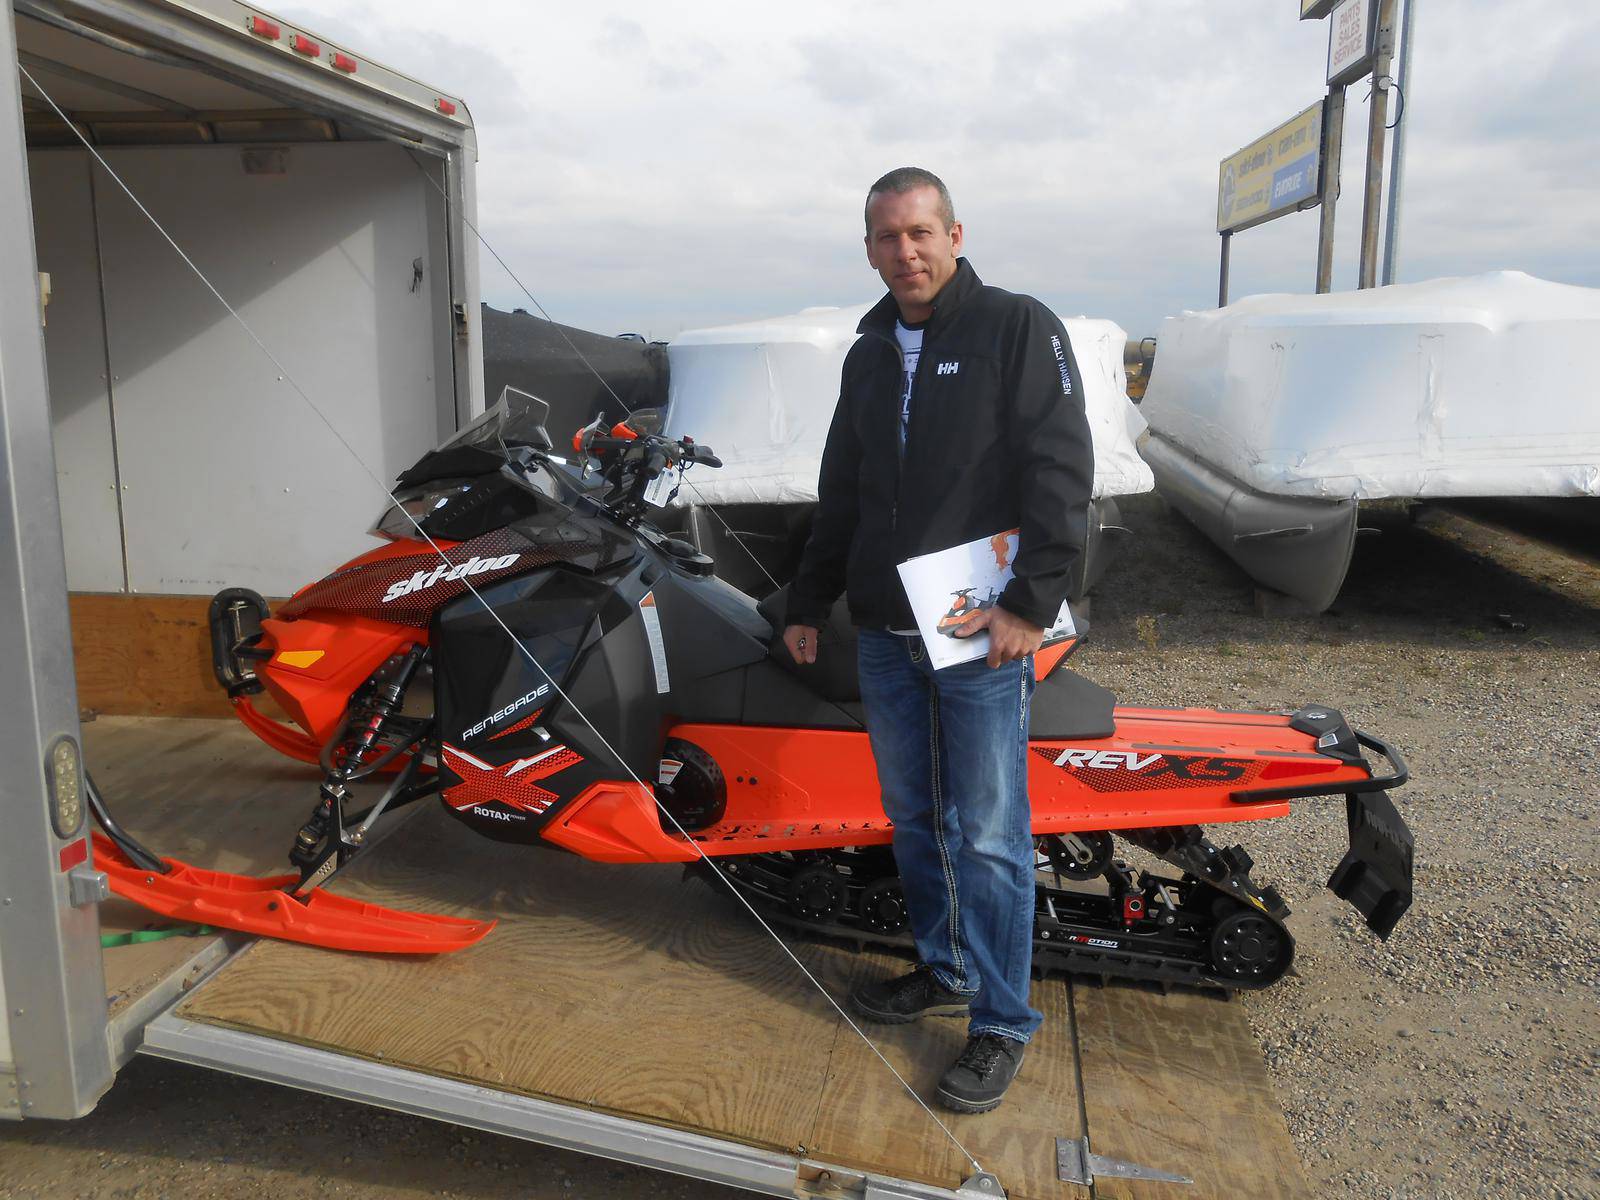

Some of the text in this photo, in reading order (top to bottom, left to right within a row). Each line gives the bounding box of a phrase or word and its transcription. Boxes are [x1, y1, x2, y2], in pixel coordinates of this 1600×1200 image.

[1334, 33, 1362, 66] SERVICE
[937, 362, 959, 375] HH
[1050, 335, 1072, 395] HELLY HANSEN
[382, 553, 520, 602] ski-doo
[462, 683, 549, 741] RENEGADE
[1054, 749, 1163, 771] REV
[474, 806, 511, 821] ROTAX
